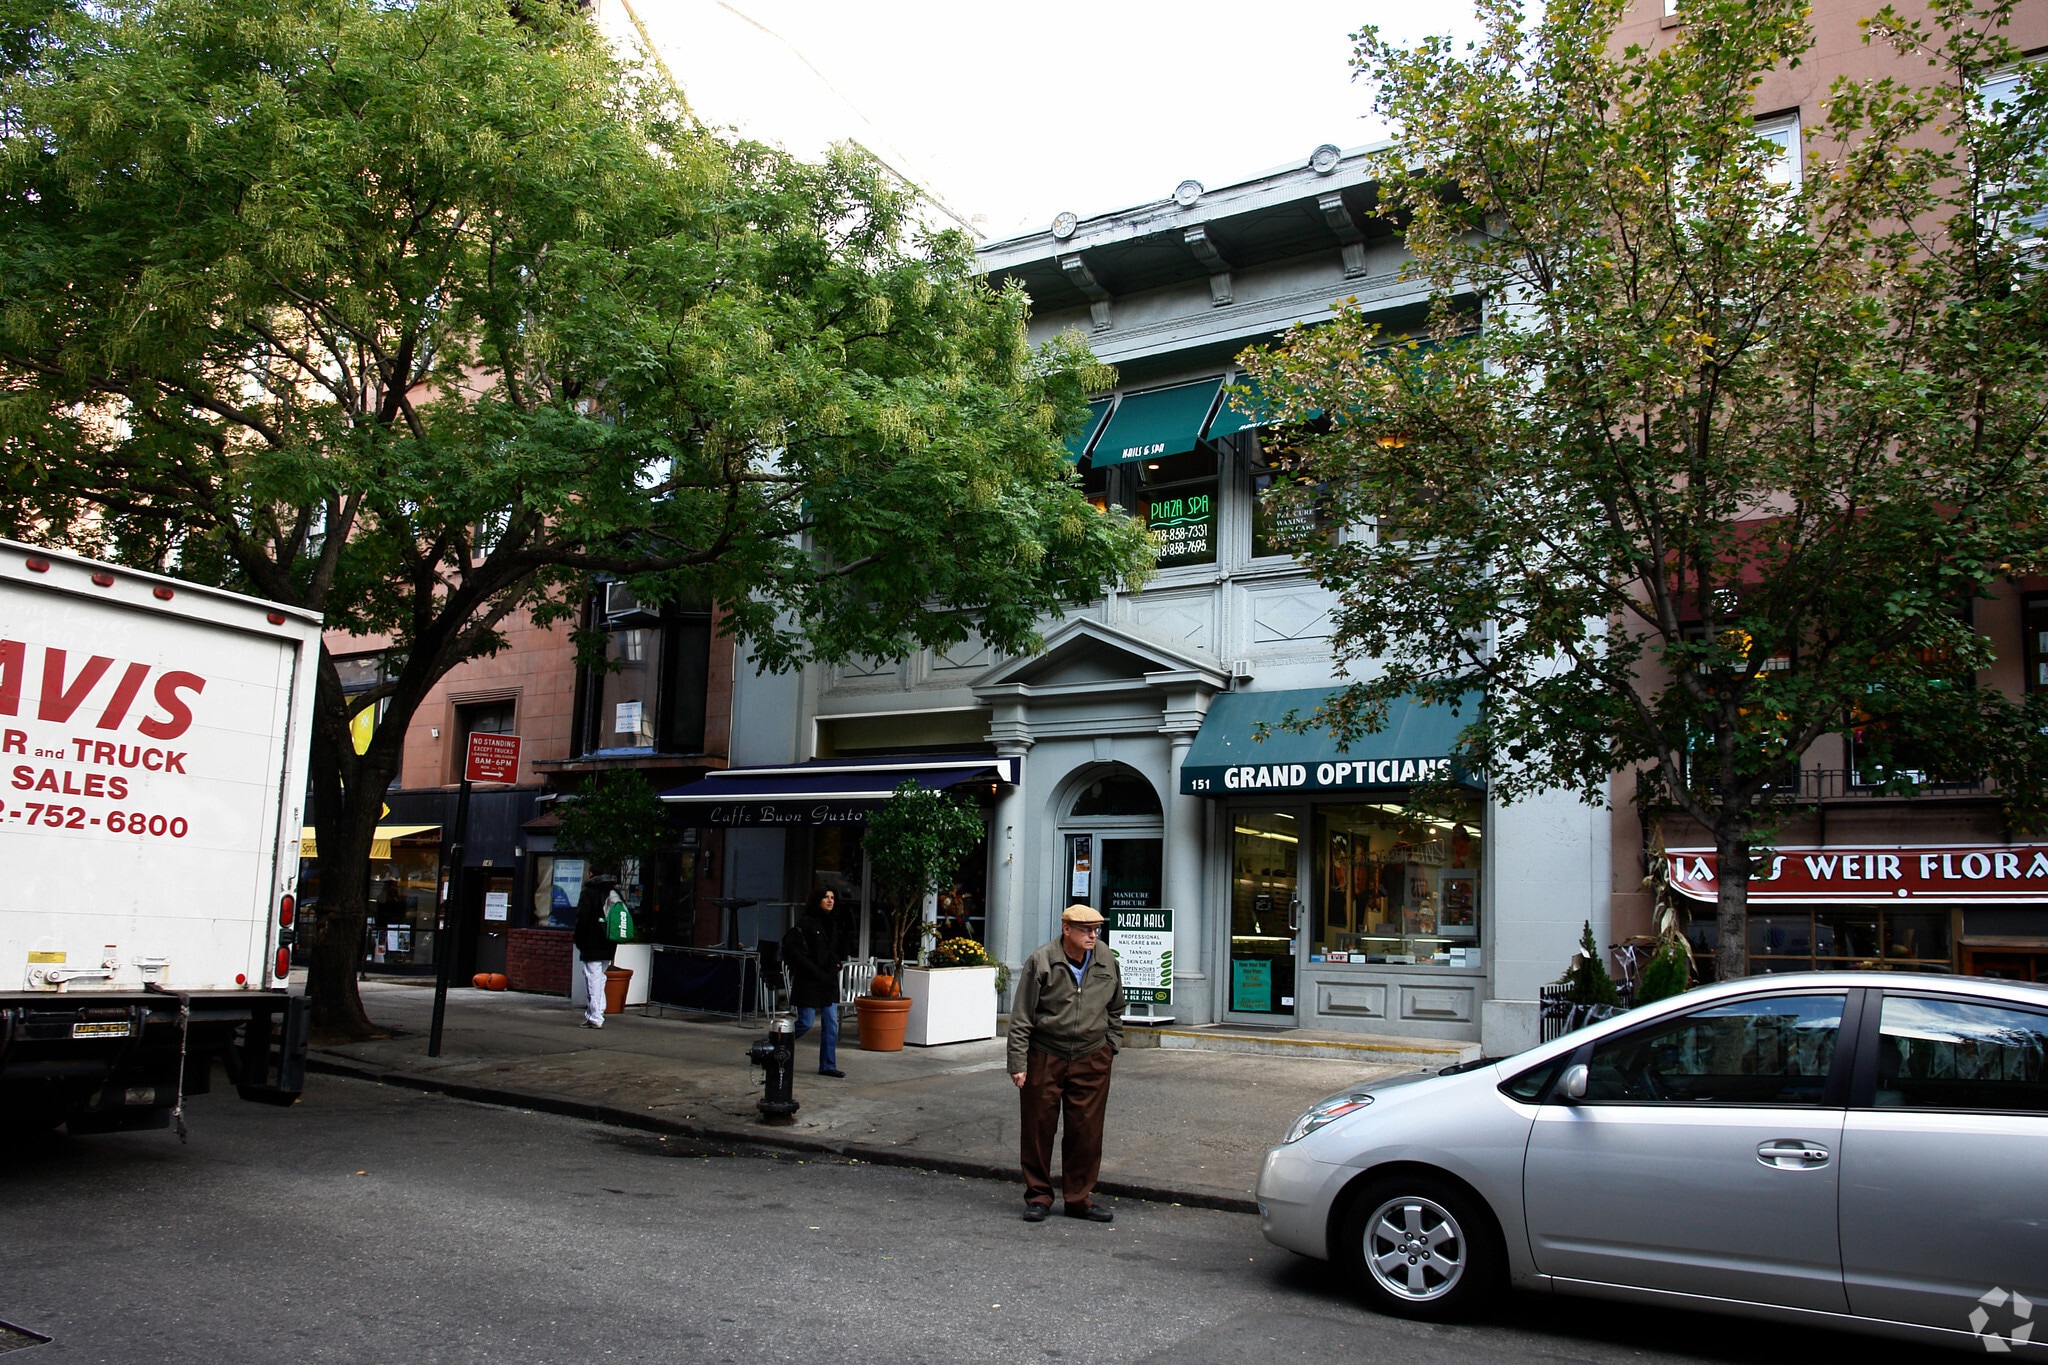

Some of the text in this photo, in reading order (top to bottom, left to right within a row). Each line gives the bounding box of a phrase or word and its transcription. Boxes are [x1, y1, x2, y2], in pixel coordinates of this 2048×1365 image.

[1122, 443, 1165, 459] NAILS & SPA
[1151, 494, 1209, 520] PLAZA SPA
[1276, 518, 1307, 526] WAXING
[1153, 524, 1208, 542] 718-858-7331
[1158, 539, 1206, 557] 18-858-7695
[484, 739, 516, 748] STANDING
[35, 748, 65, 760] and
[72, 737, 188, 775] TRUCK
[475, 757, 512, 767] 8AM-6PM
[11, 765, 129, 800] SALES
[1224, 764, 1306, 789] GRAND
[1316, 758, 1452, 786] OPTICIANS
[1192, 779, 1210, 790] 151
[0, 799, 188, 838] -752-6800
[710, 805, 863, 825] Caffe Buon Gusto
[1676, 852, 2048, 883] JAS WEIR FLORA
[618, 911, 627, 938] prince
[1118, 913, 1165, 928] PLAZA NAILS
